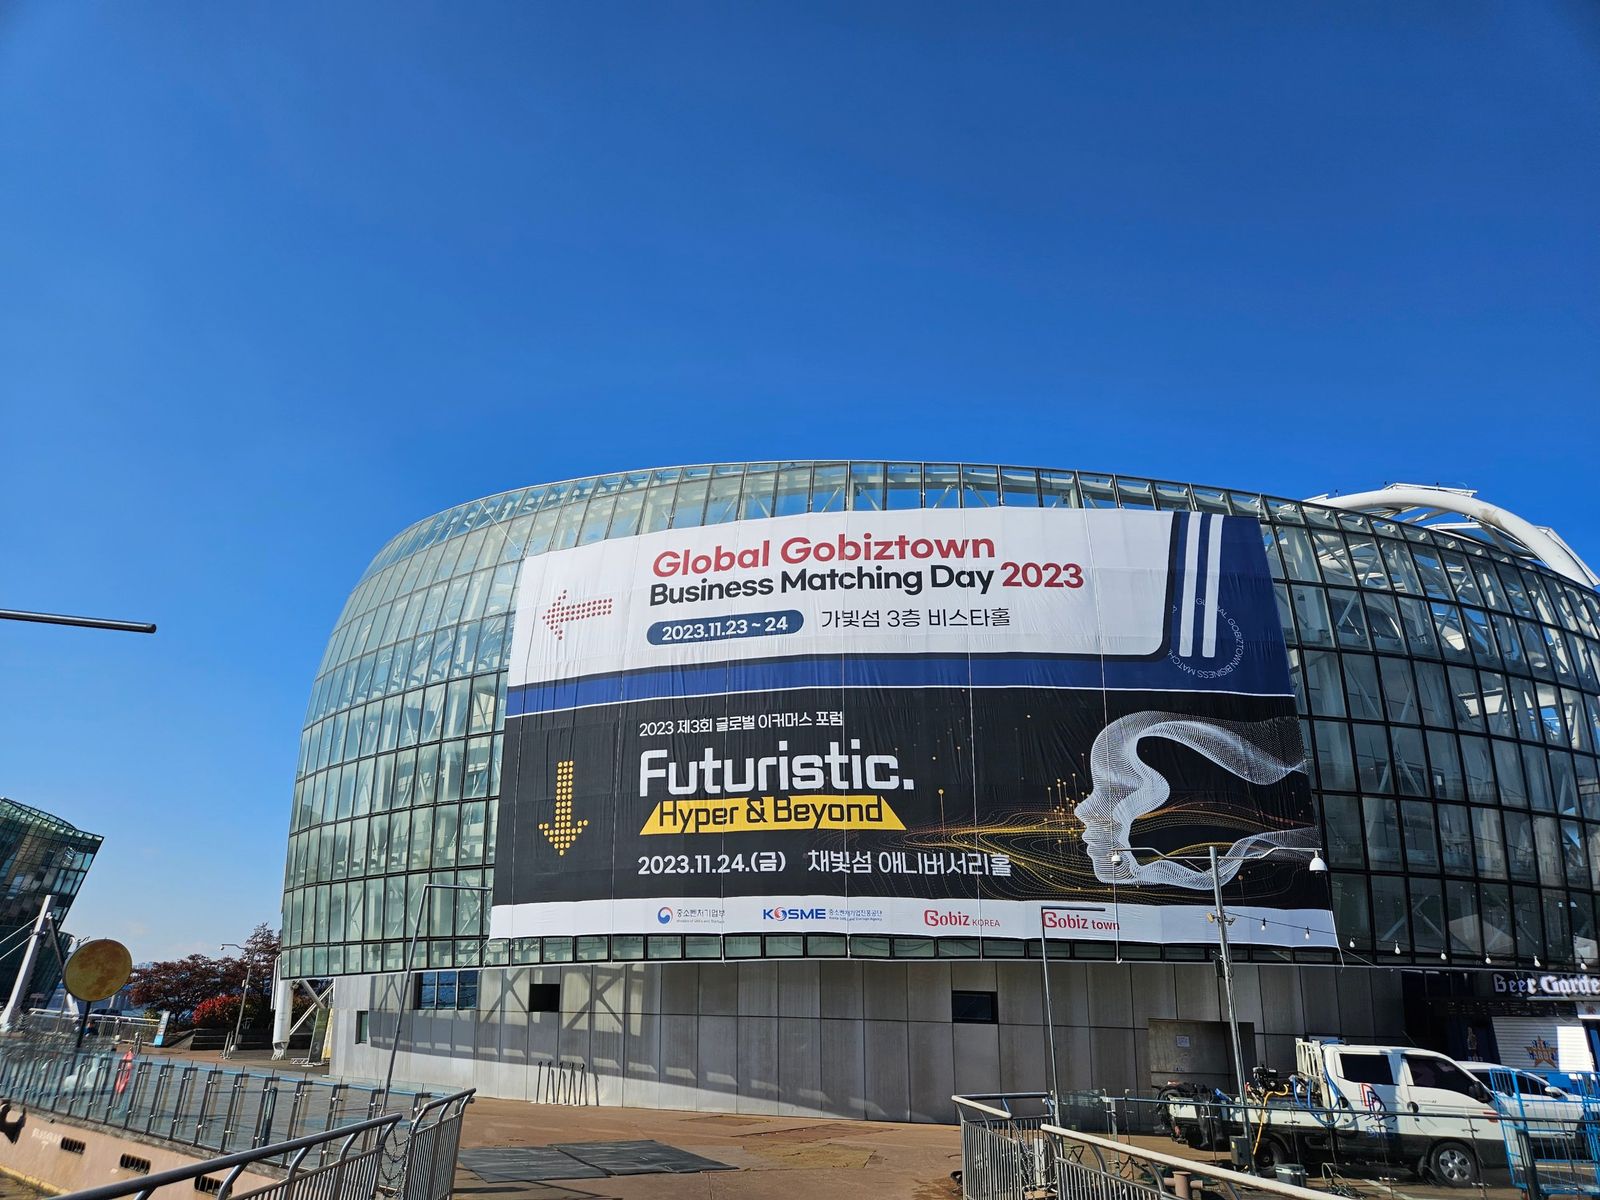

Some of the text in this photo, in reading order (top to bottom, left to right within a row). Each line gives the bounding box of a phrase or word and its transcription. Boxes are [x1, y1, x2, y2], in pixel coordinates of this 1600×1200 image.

[652, 532, 996, 578] Global Gobiztown
[649, 561, 1084, 606] Business Matching Day 2023
[661, 620, 748, 641] 2023.11.23
[764, 615, 788, 632] 24
[821, 607, 1011, 628] 가빛섬 3층 비스타홀
[639, 710, 844, 737] 2023 제3회 글로벌 이커머스 포럼
[639, 738, 914, 798] Futuristic.
[659, 795, 884, 834] Hyper & Beyond
[637, 849, 1012, 877] 2023.11.24.(금) 채빛섬 애니버서리홀
[763, 907, 826, 921] KOSME
[924, 909, 1000, 928] Gobiz KOREA
[1091, 919, 1120, 931] town
[1493, 973, 1537, 994] Beer
